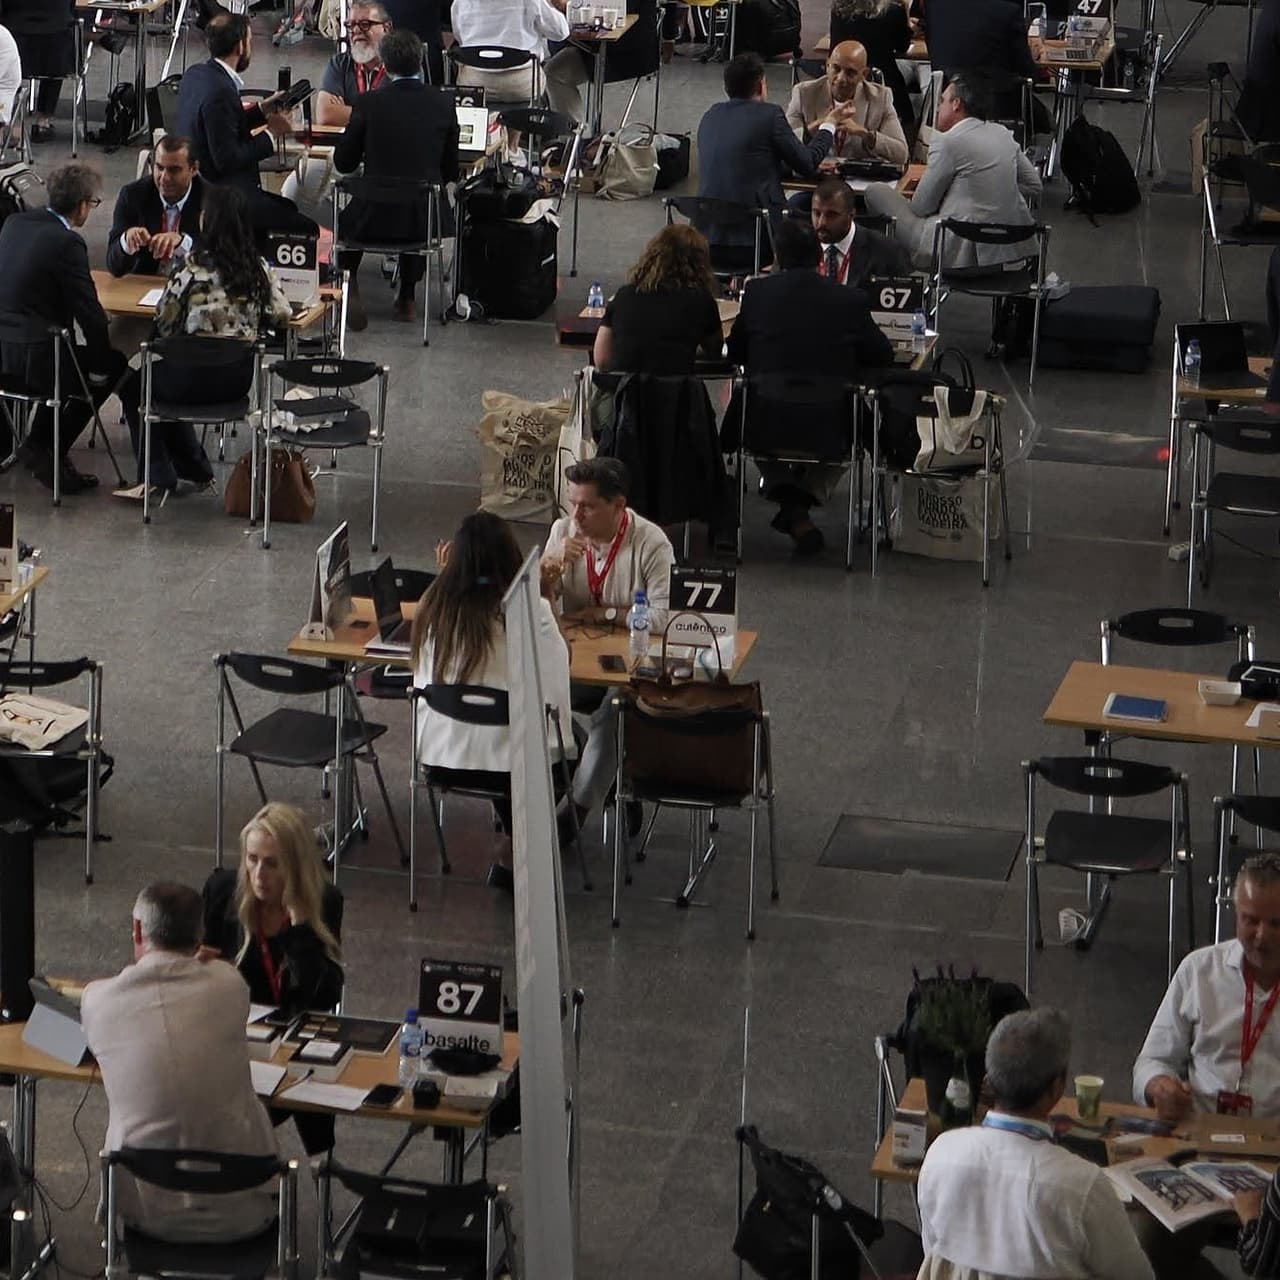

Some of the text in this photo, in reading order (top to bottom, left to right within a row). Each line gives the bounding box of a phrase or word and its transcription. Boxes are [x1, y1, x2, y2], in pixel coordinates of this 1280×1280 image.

[276, 243, 306, 265] 66
[879, 287, 912, 309] 67
[683, 581, 722, 608] 77
[436, 982, 484, 1015] 87
[424, 1029, 490, 1052] basalte
